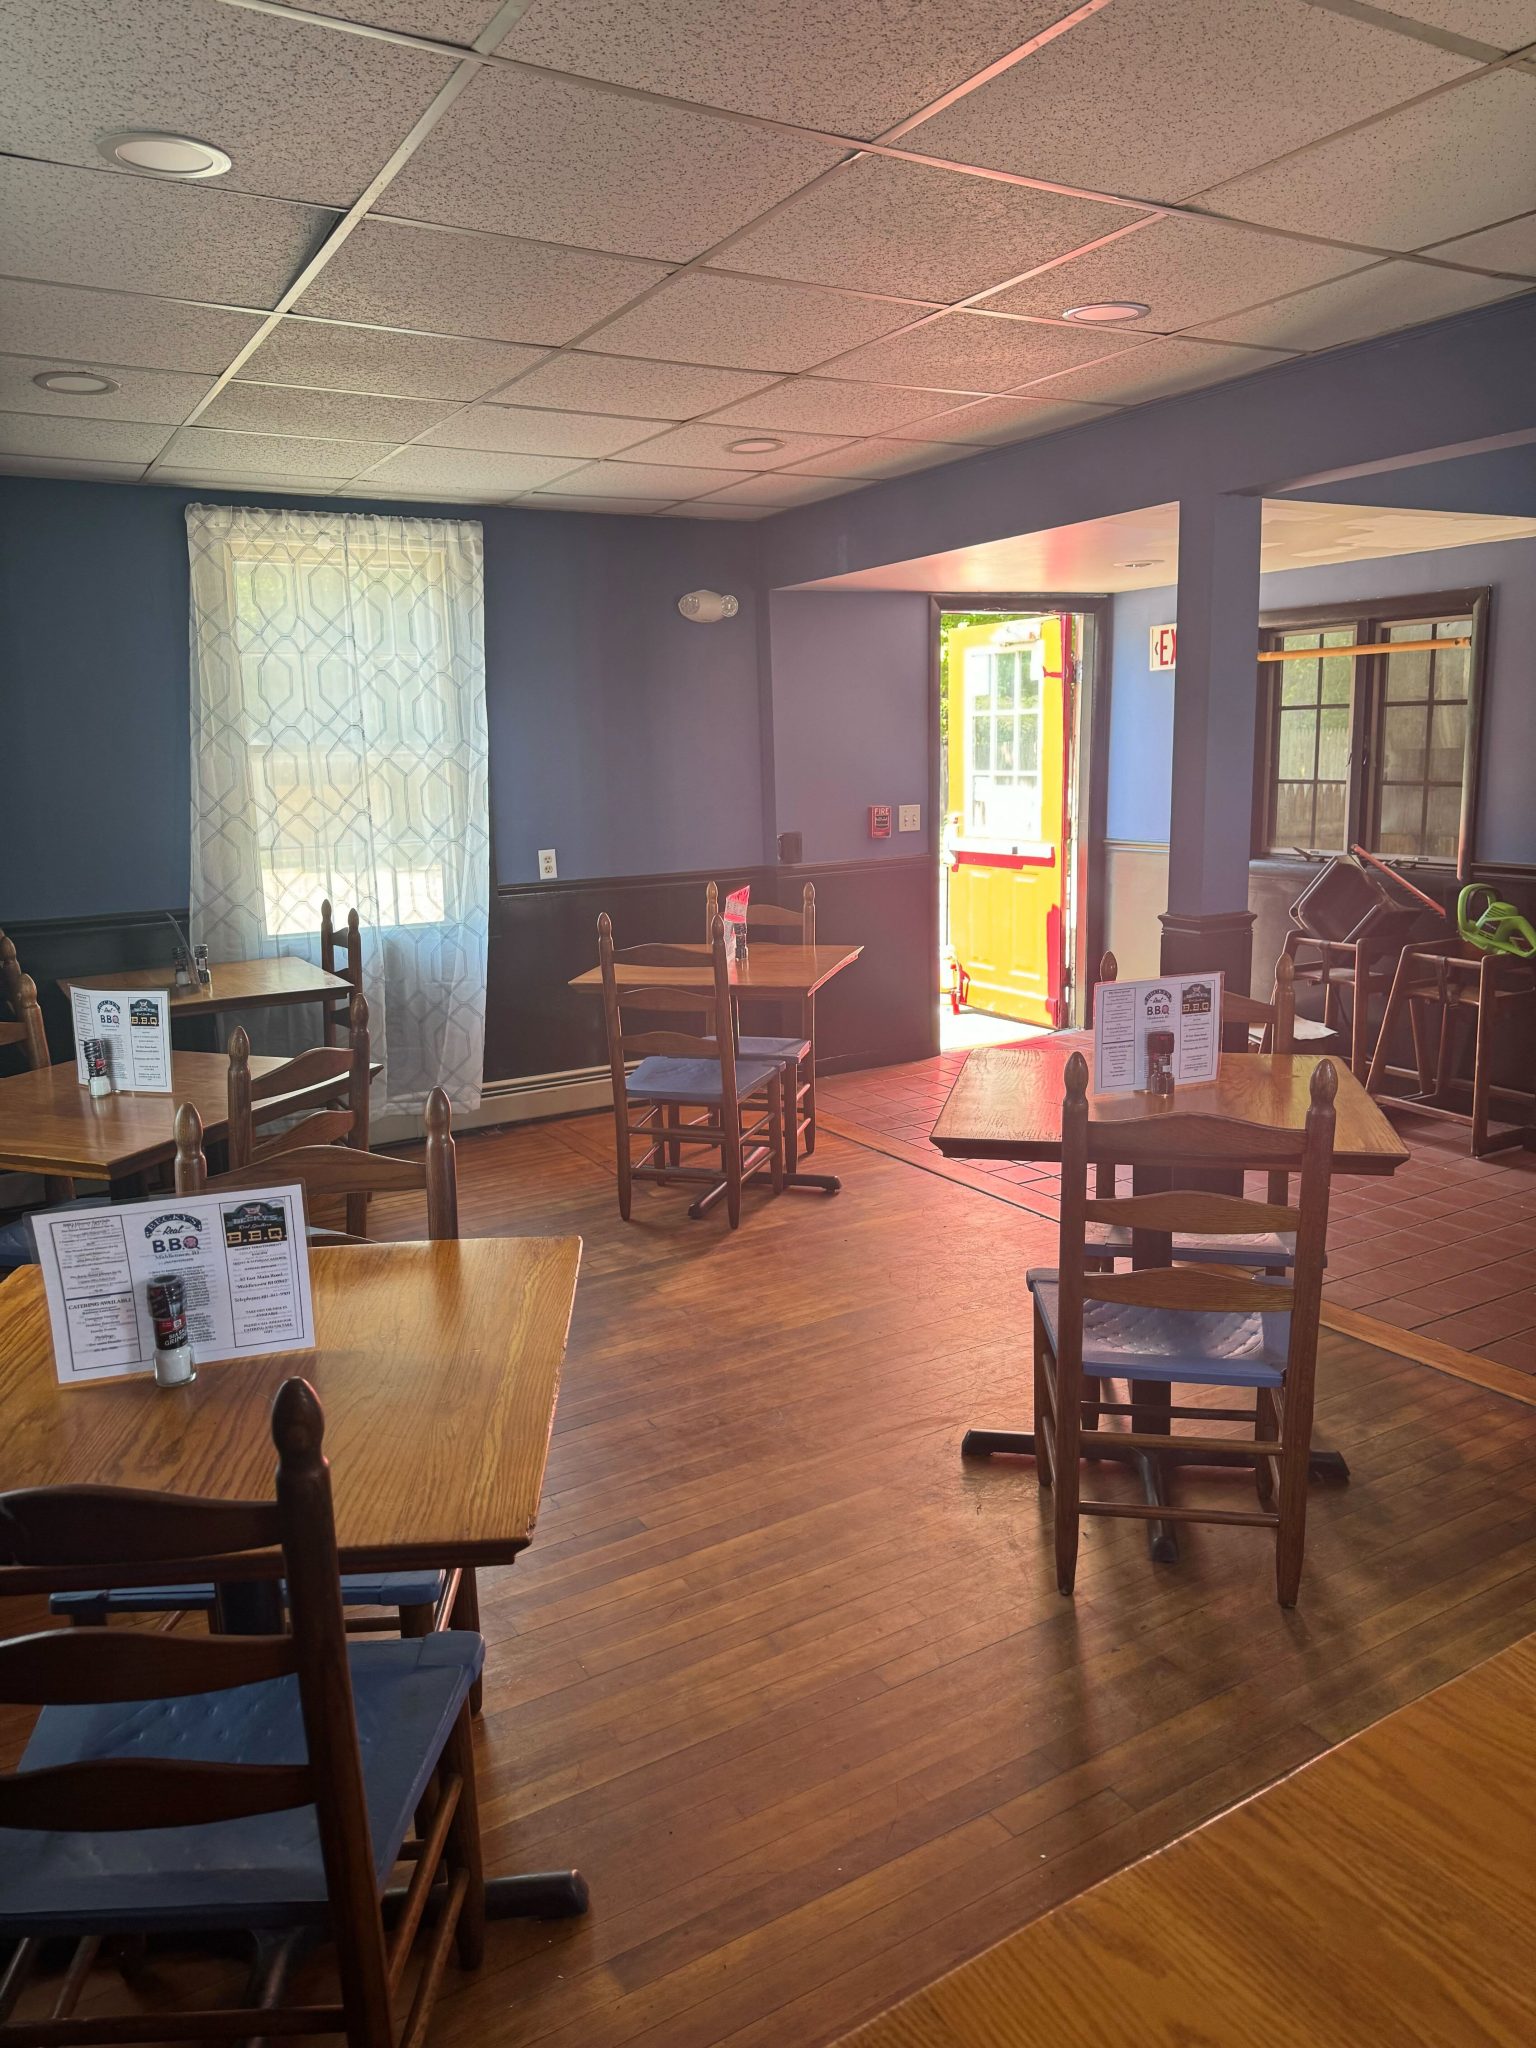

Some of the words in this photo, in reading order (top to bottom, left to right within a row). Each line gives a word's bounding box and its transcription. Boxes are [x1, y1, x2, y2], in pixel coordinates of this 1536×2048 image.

[1160, 629, 1177, 666] EX
[874, 807, 890, 815] FIRE
[162, 1225, 185, 1235] Real
